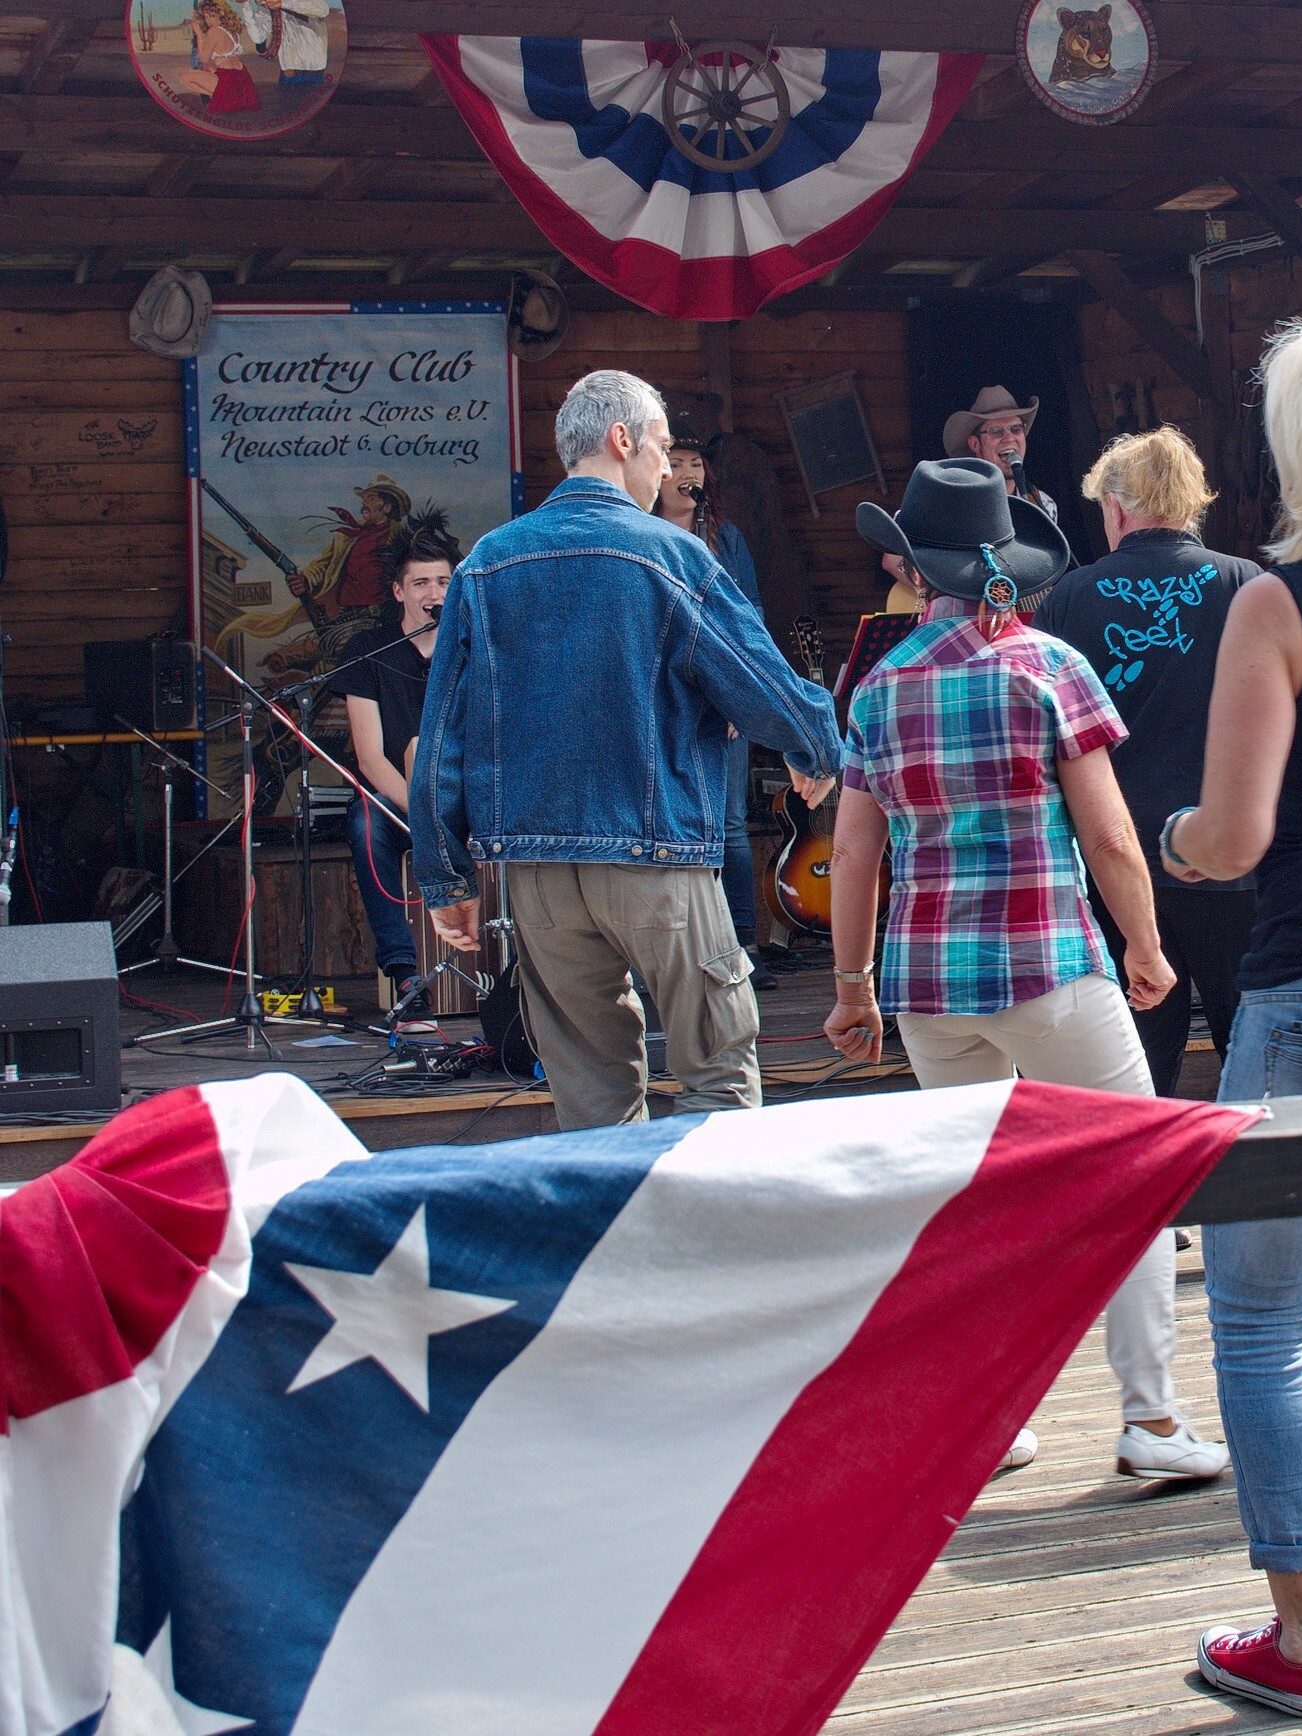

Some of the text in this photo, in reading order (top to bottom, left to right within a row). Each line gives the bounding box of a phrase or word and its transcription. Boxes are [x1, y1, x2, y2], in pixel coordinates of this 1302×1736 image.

[218, 349, 478, 394] Country Club
[210, 393, 352, 427] Mountain
[360, 400, 434, 429] Lions
[220, 430, 351, 464] Neustadt
[381, 433, 481, 468] Coburg
